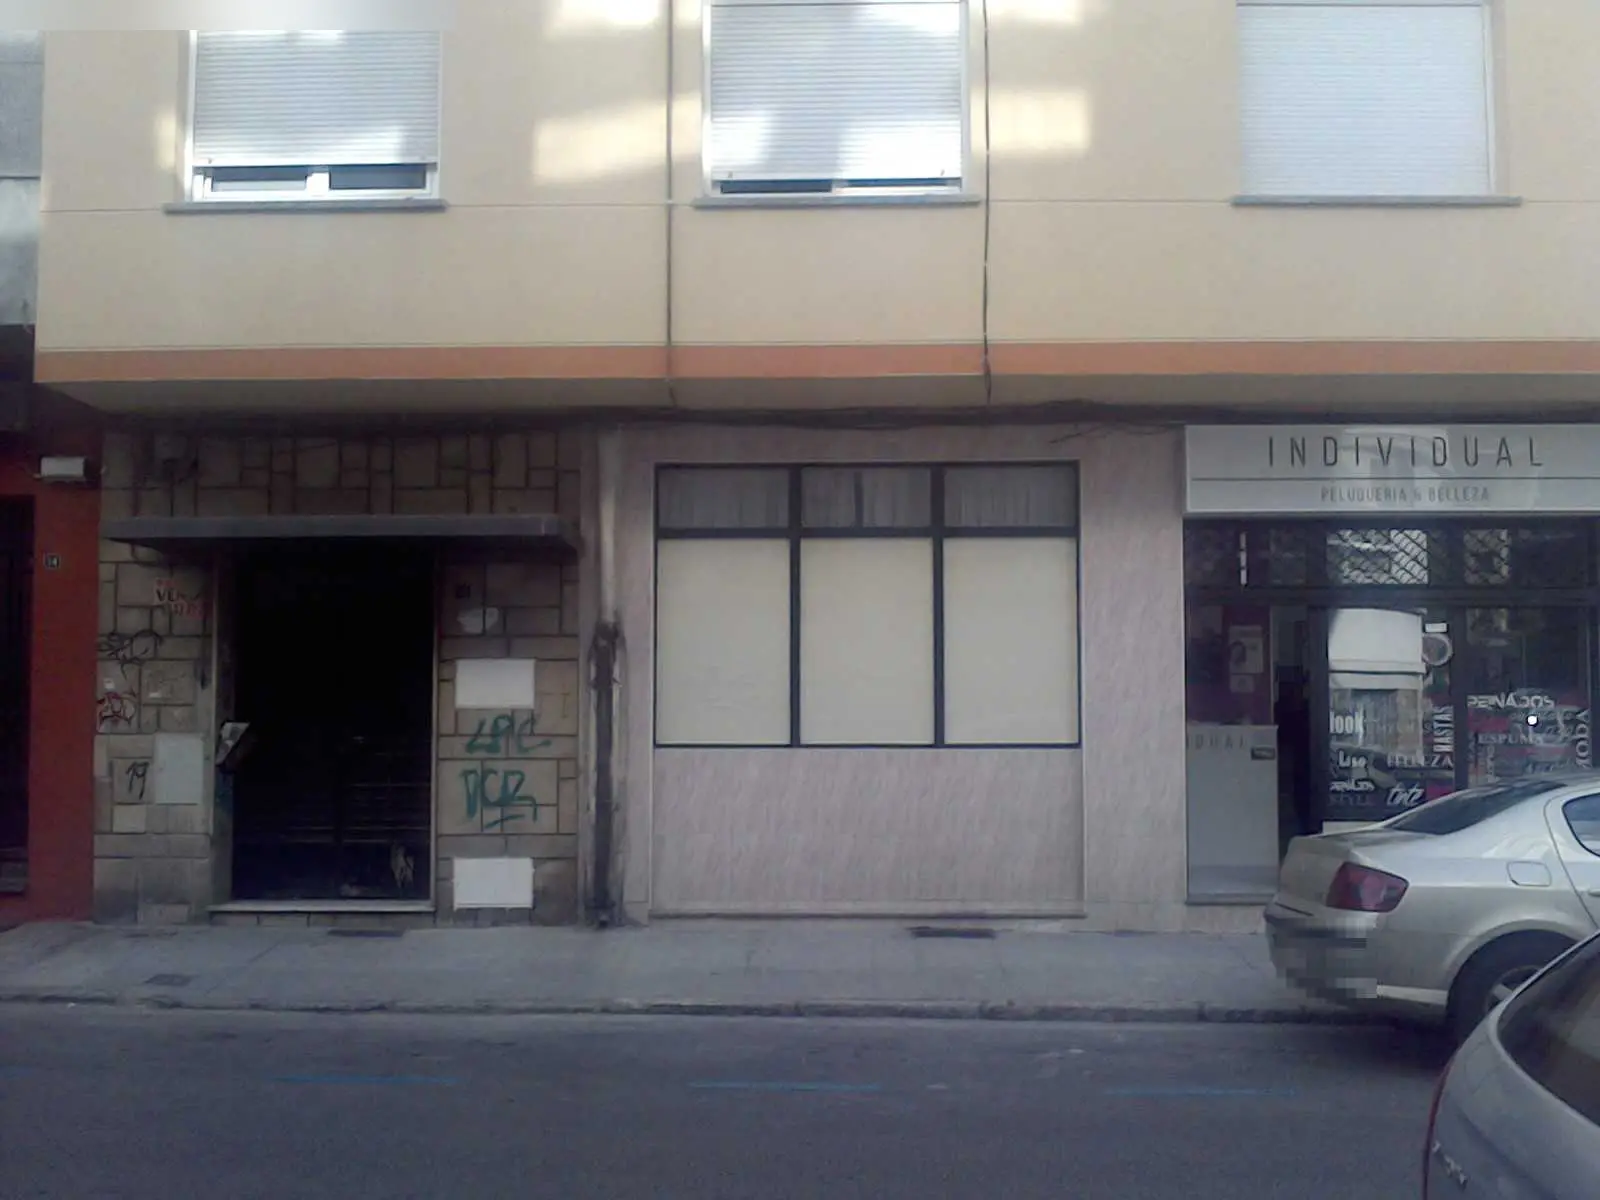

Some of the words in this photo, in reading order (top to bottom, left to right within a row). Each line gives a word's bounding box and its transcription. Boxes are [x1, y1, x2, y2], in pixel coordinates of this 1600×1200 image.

[1268, 436, 1544, 468] INDIVIDUAL
[1427, 486, 1490, 502] BELLEZA
[1329, 711, 1364, 734] look
